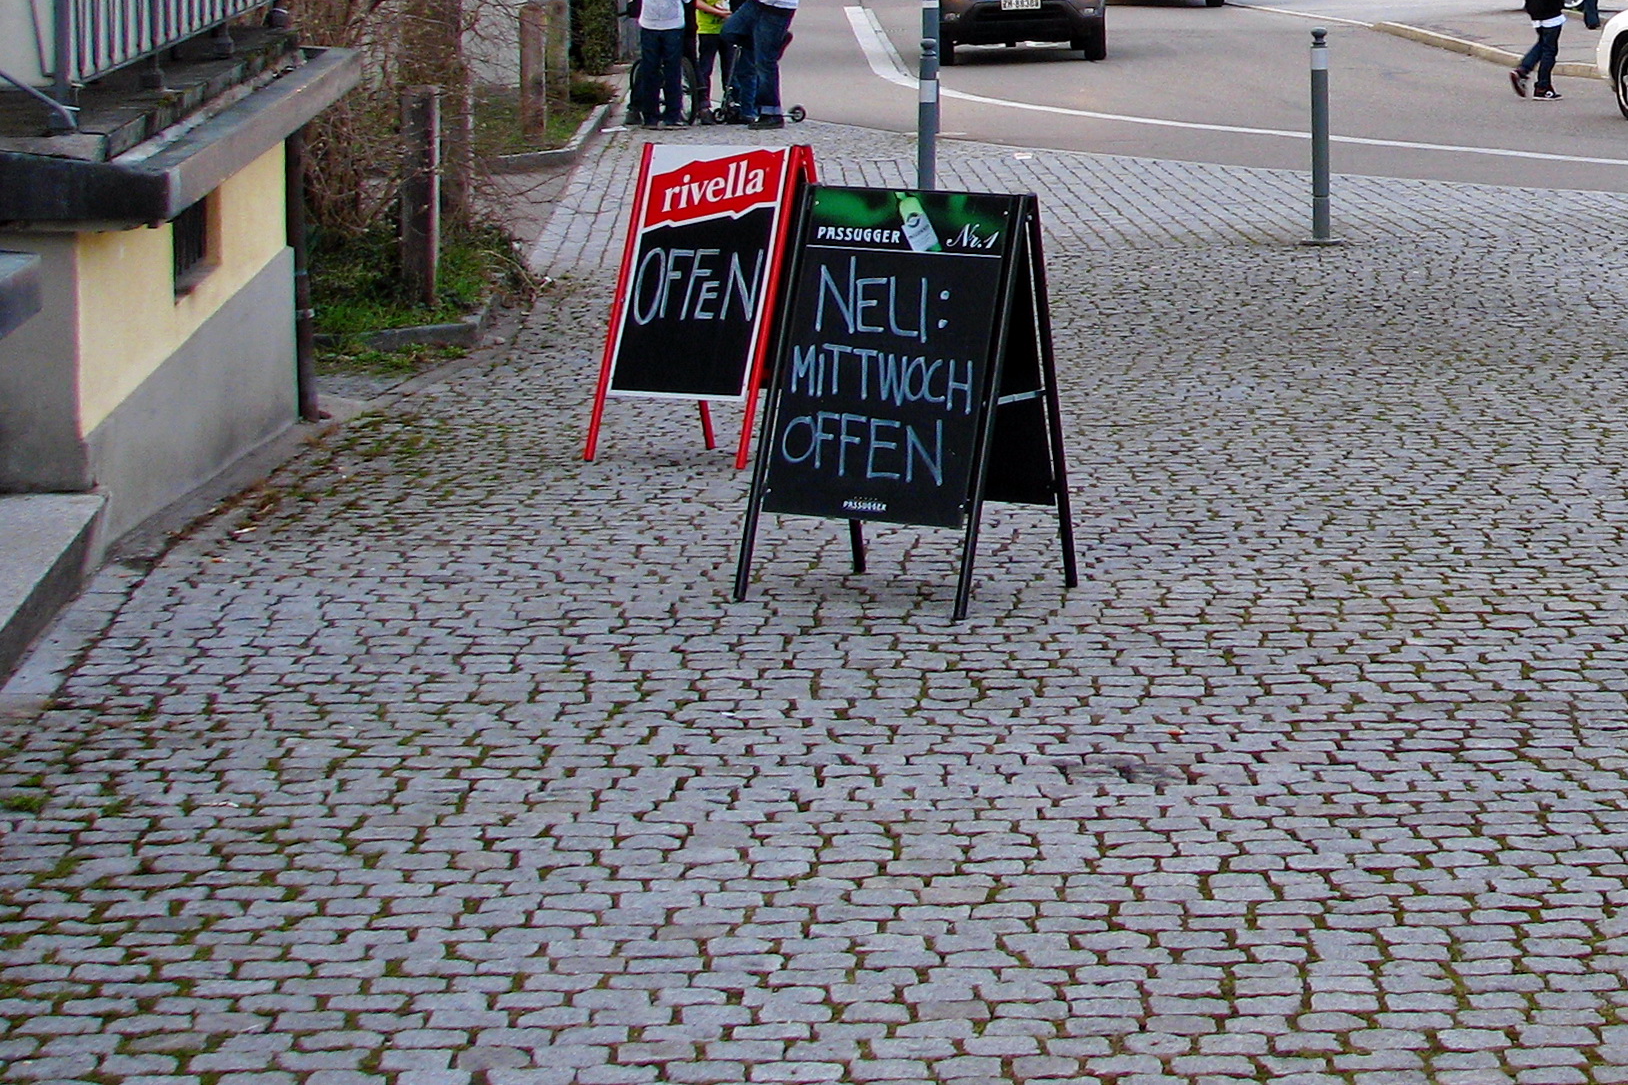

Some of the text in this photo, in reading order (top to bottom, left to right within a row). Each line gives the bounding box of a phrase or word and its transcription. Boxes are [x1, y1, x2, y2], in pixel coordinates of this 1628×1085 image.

[661, 159, 764, 212] rivella
[816, 226, 900, 244] PASSUGGER
[633, 248, 764, 326] OFFEN
[781, 412, 944, 486] OFFEN
